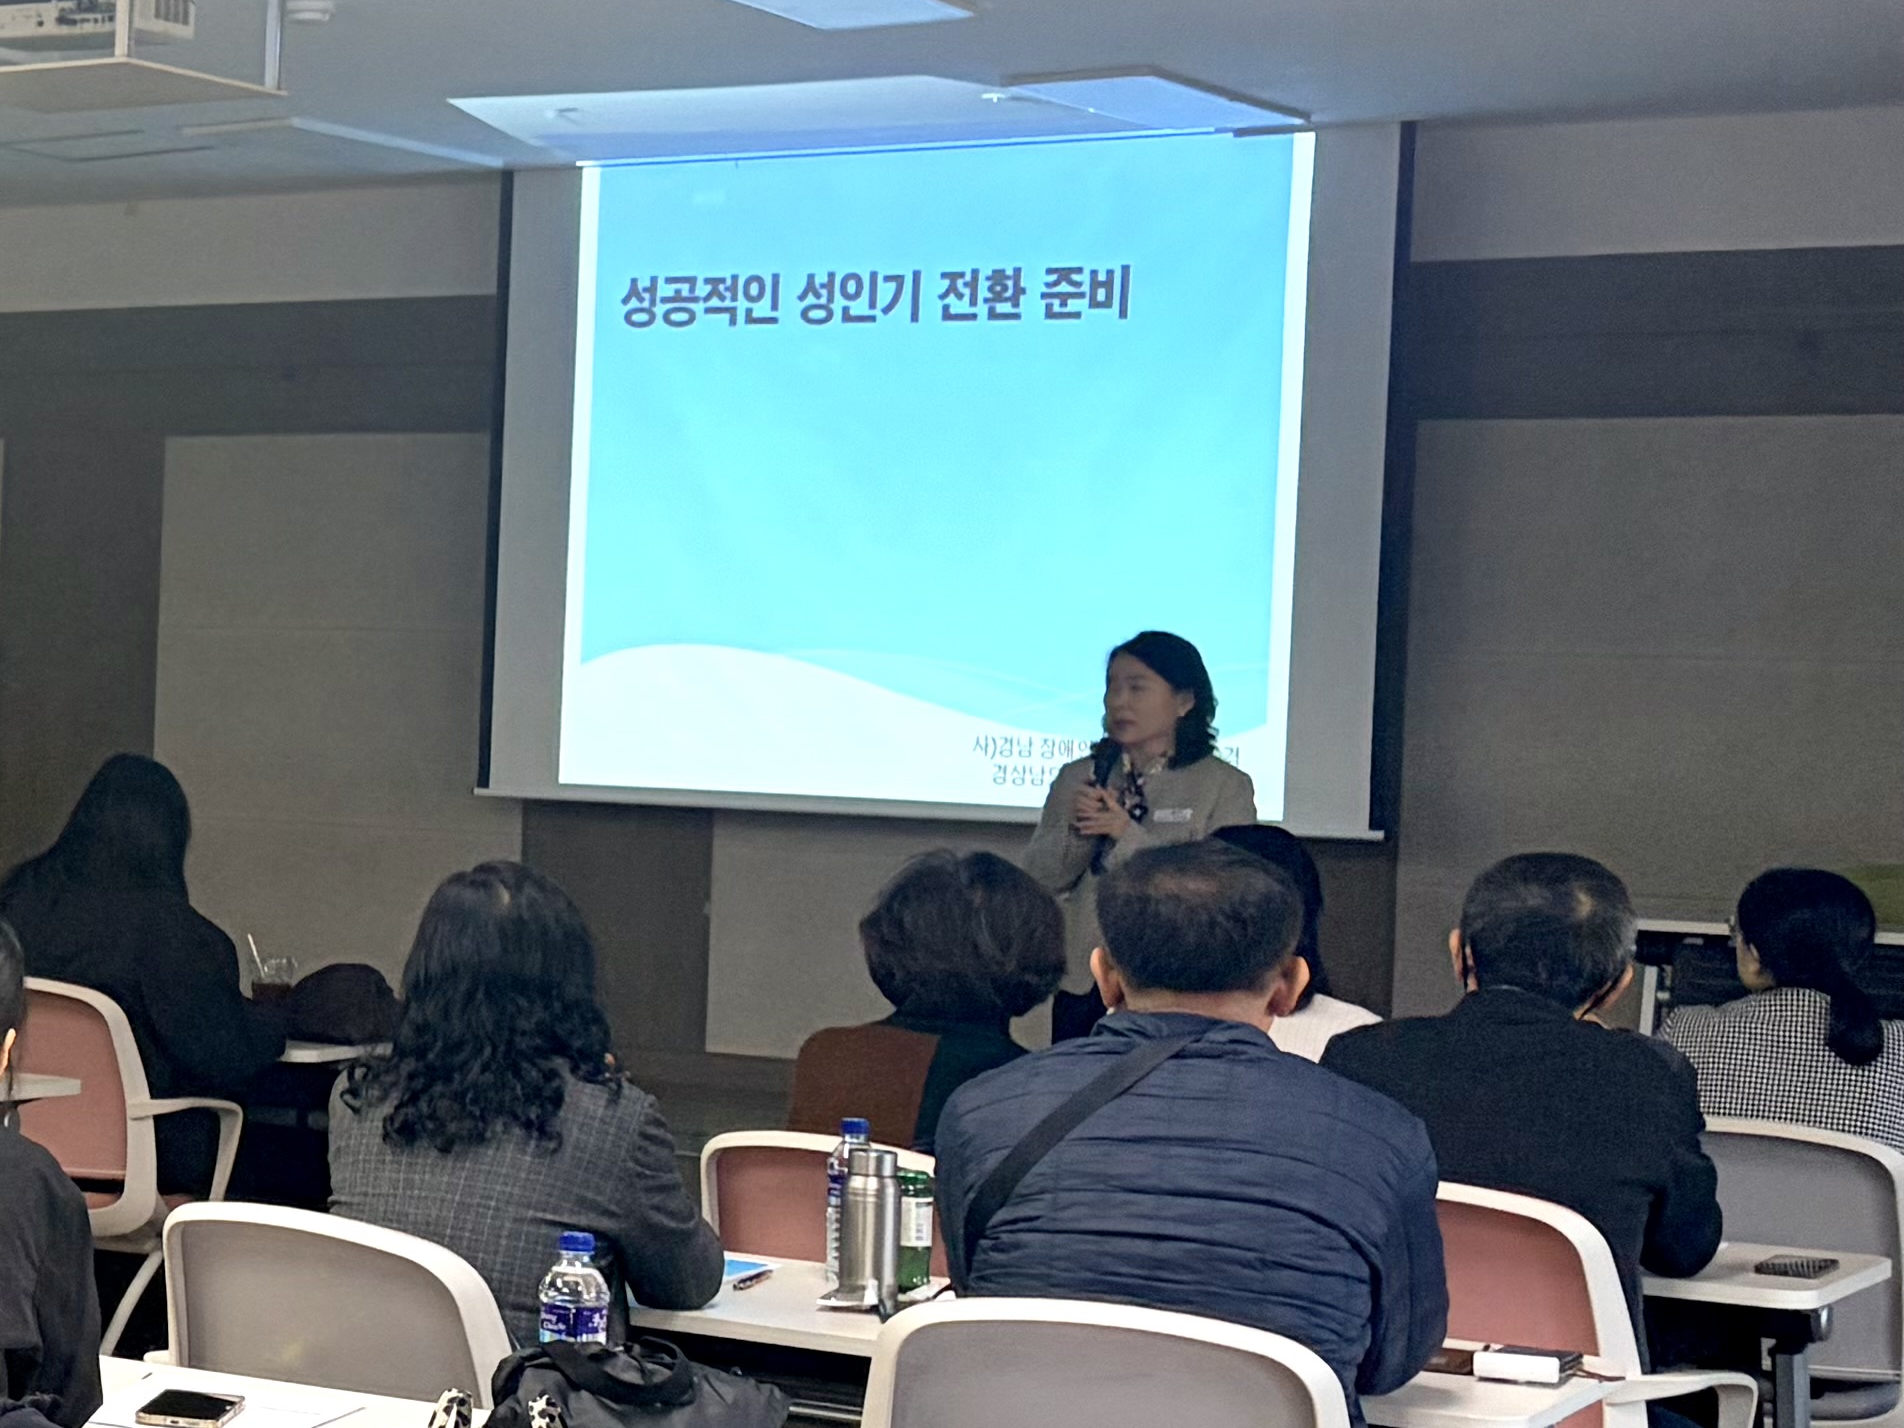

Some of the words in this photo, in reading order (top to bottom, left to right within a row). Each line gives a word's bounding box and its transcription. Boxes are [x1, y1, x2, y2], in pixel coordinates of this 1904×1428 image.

[620, 272, 782, 329] 성공적인
[796, 269, 921, 325] 성인기
[937, 267, 1027, 322] 전환
[1040, 264, 1132, 321] 준비
